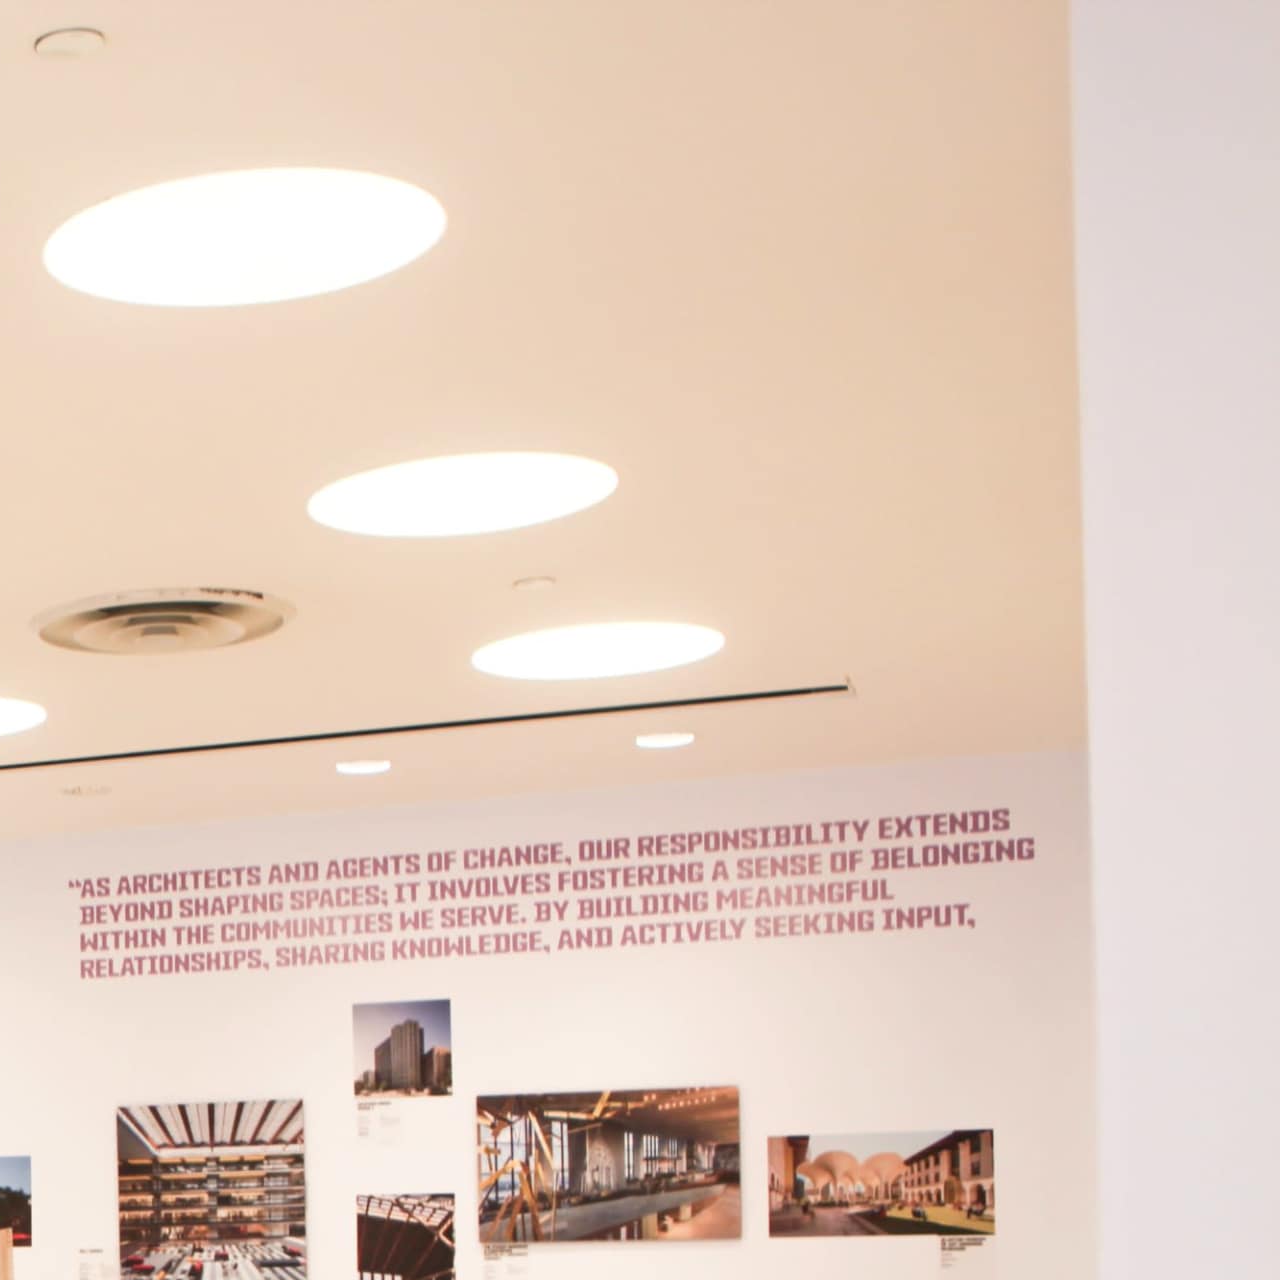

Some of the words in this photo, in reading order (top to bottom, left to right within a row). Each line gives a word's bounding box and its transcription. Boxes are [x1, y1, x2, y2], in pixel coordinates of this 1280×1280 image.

[80, 900, 173, 925] BEYOND
[179, 891, 283, 919] SHAPING
[290, 885, 388, 911] SPACES;
[394, 882, 421, 903] IT
[428, 873, 550, 901] INVOLVES
[558, 862, 704, 892] FOSTERING
[712, 860, 729, 882] A
[737, 853, 822, 880] SENSE
[830, 850, 863, 874] OF
[871, 838, 1035, 871] BELONGING
[117, 866, 261, 896] ARCHITECTS
[268, 862, 319, 885] AND
[326, 854, 420, 880] AGENTS
[427, 851, 457, 873] OF
[463, 842, 572, 870] CHANGE,
[578, 838, 630, 862] OUR
[638, 820, 869, 857] RESPONSIBILITY
[878, 808, 1010, 840] EXTENDS
[80, 927, 166, 952] WITHIN
[172, 925, 215, 946] THE
[221, 913, 392, 943] COMMUNITIES
[399, 910, 433, 931] WE
[441, 904, 526, 928] SERVE.
[534, 900, 569, 923] BY
[577, 891, 708, 919] BUILDING
[716, 879, 894, 911] MEANINGFUL
[80, 950, 270, 979] RELATIONSHIPS,
[276, 941, 385, 967] SHARING
[392, 931, 550, 961] KNOWLEDGE,
[557, 926, 612, 950] AND
[620, 918, 746, 946] ACTIVELY
[755, 910, 874, 938] SEEKING
[882, 904, 975, 931] INPUT,
